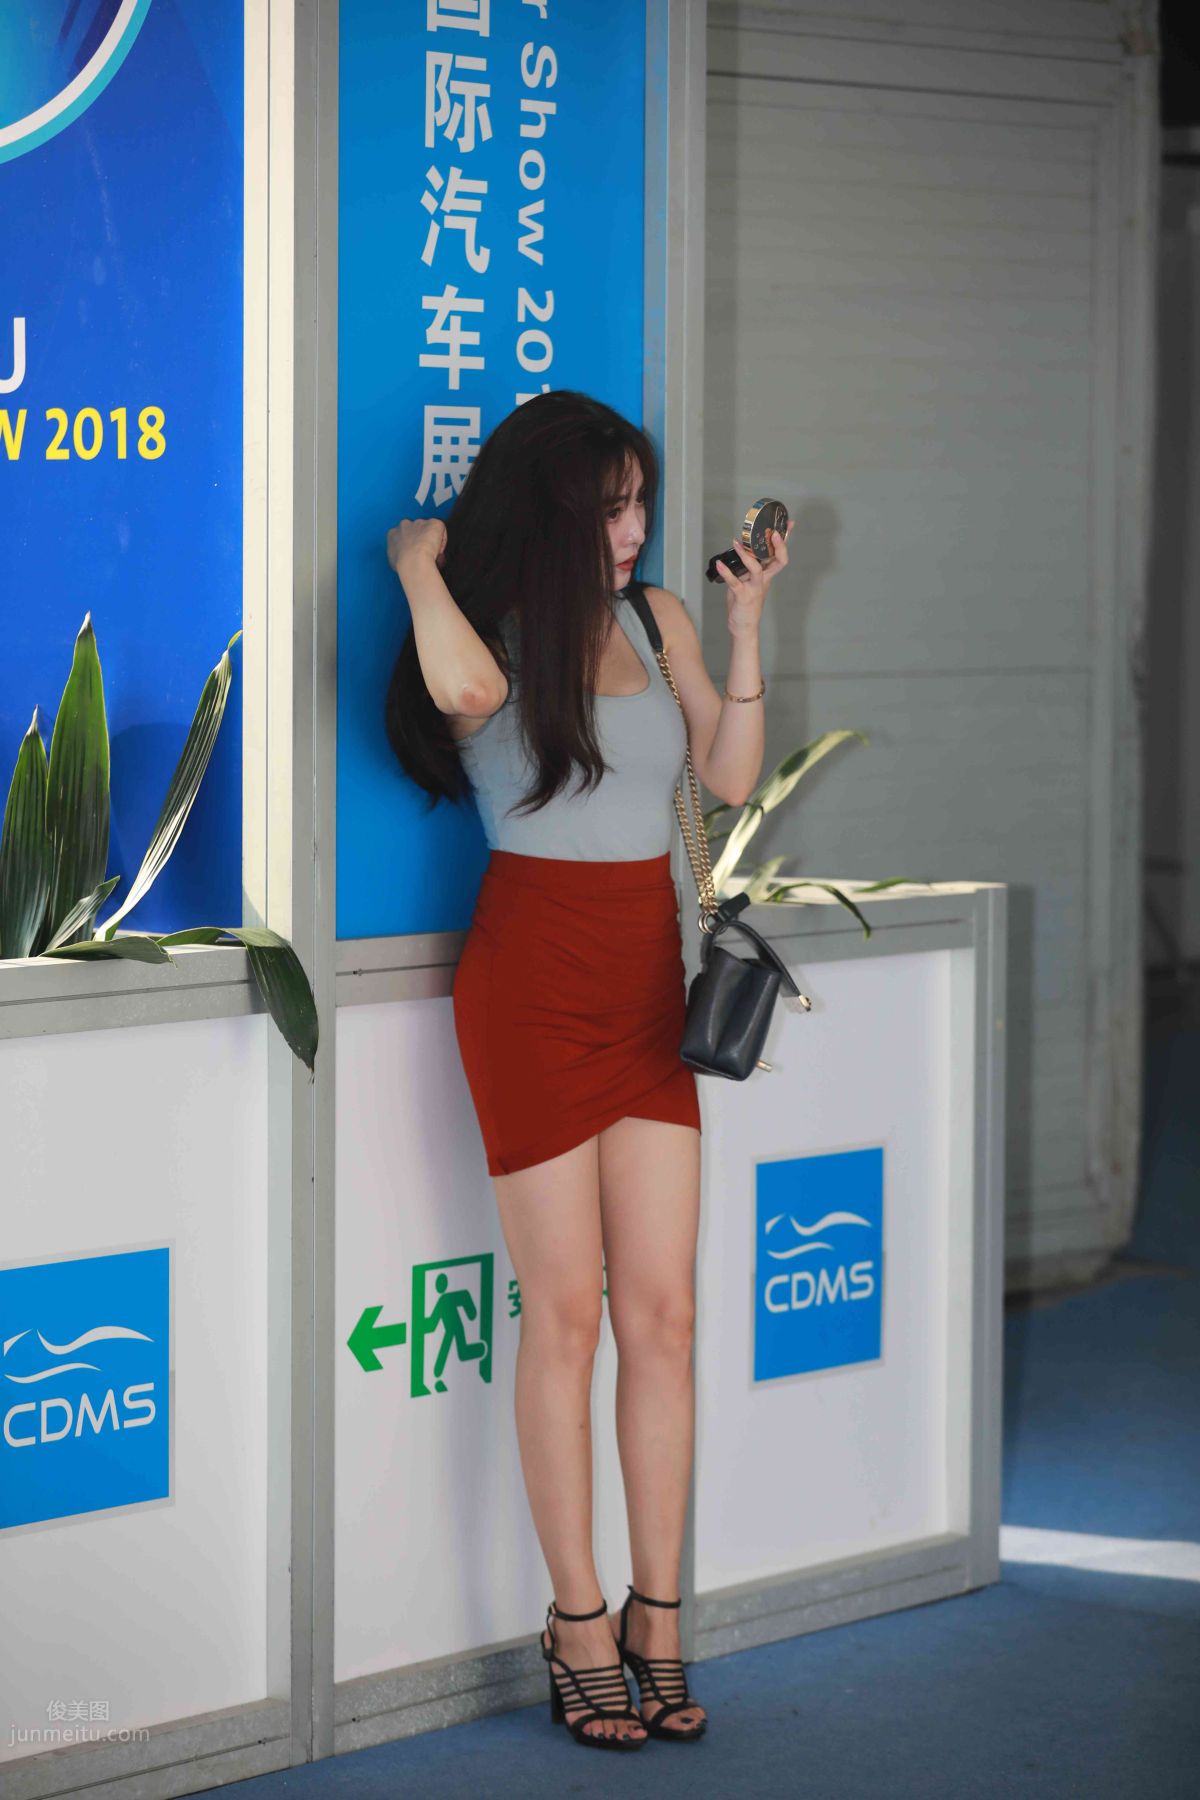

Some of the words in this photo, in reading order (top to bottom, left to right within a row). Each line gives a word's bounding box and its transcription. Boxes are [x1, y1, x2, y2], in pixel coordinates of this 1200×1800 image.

[517, 41, 558, 266] Show
[45, 405, 167, 461] 2018
[764, 1260, 875, 1314] CDMS
[3, 1382, 156, 1448] CDMS
